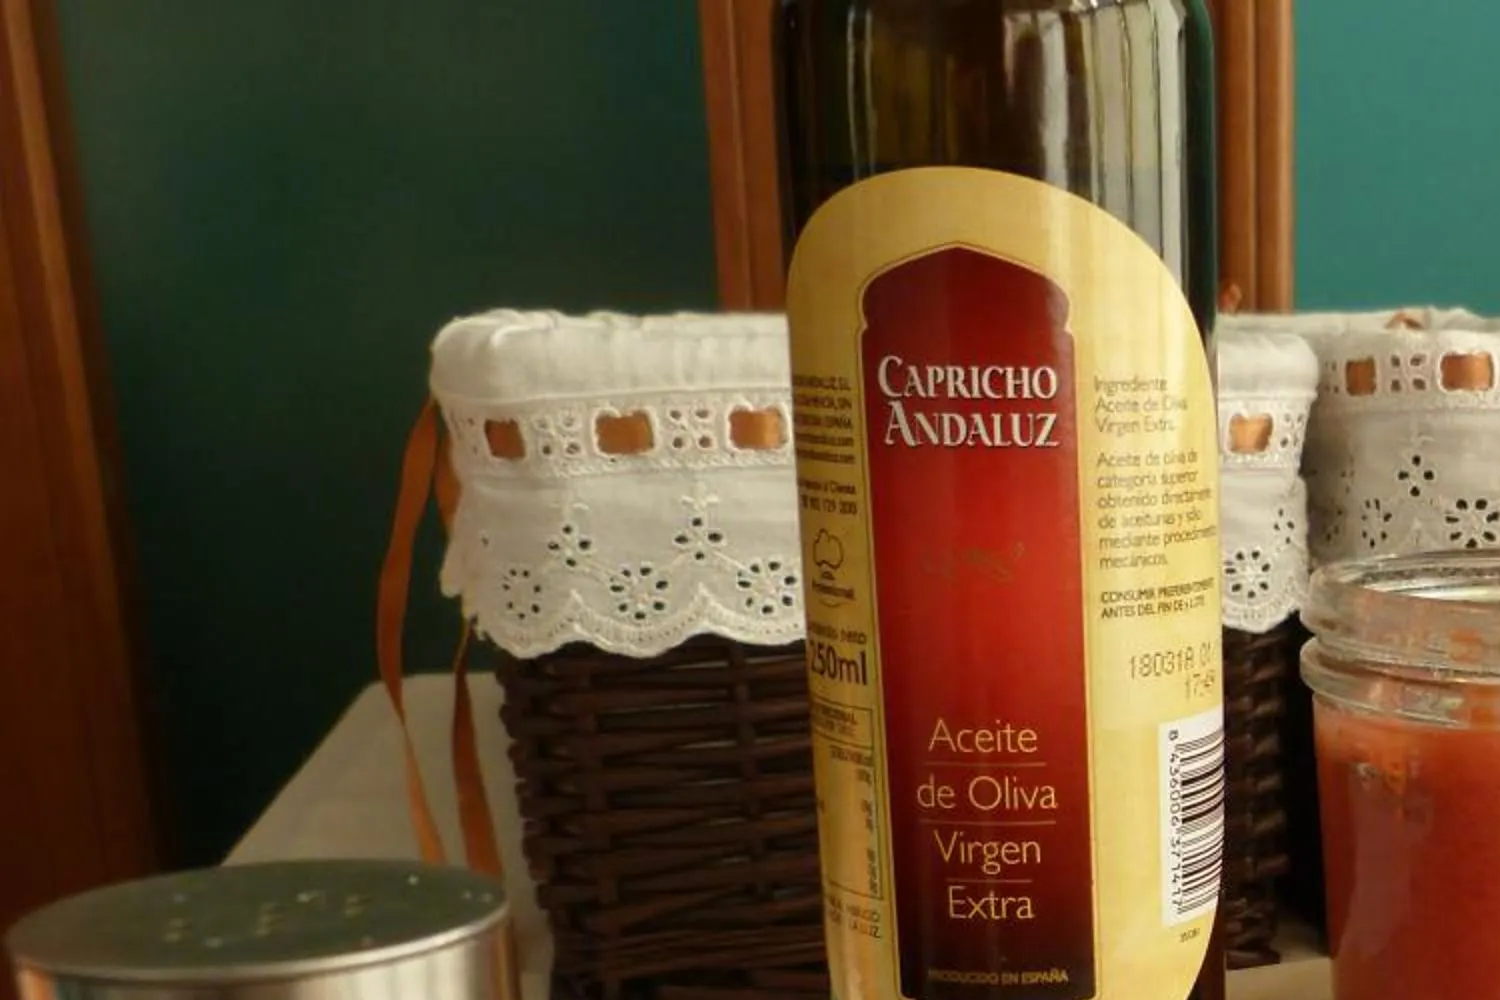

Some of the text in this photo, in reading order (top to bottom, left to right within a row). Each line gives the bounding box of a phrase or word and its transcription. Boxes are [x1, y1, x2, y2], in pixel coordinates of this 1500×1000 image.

[878, 355, 1057, 400] CAPRICHO
[1094, 396, 1140, 413] Aceite
[1142, 397, 1160, 412] de
[884, 400, 1060, 448] ANDALUZ
[1094, 414, 1140, 438] Virgen
[1096, 451, 1141, 468] Aceite
[1144, 449, 1161, 466] de
[1097, 491, 1157, 510] obtenido
[1097, 512, 1116, 530] de
[1098, 532, 1160, 550] mediante
[1101, 604, 1137, 620] ANTES
[1137, 602, 1156, 617] DEL
[928, 716, 1039, 754] Aceite
[916, 773, 957, 810] de
[968, 774, 1060, 811] Oliva
[933, 828, 1042, 875] Virgen
[947, 885, 1036, 920] Extra
[1001, 971, 1019, 985] EN
[1021, 966, 1069, 986] ESPAÑA
